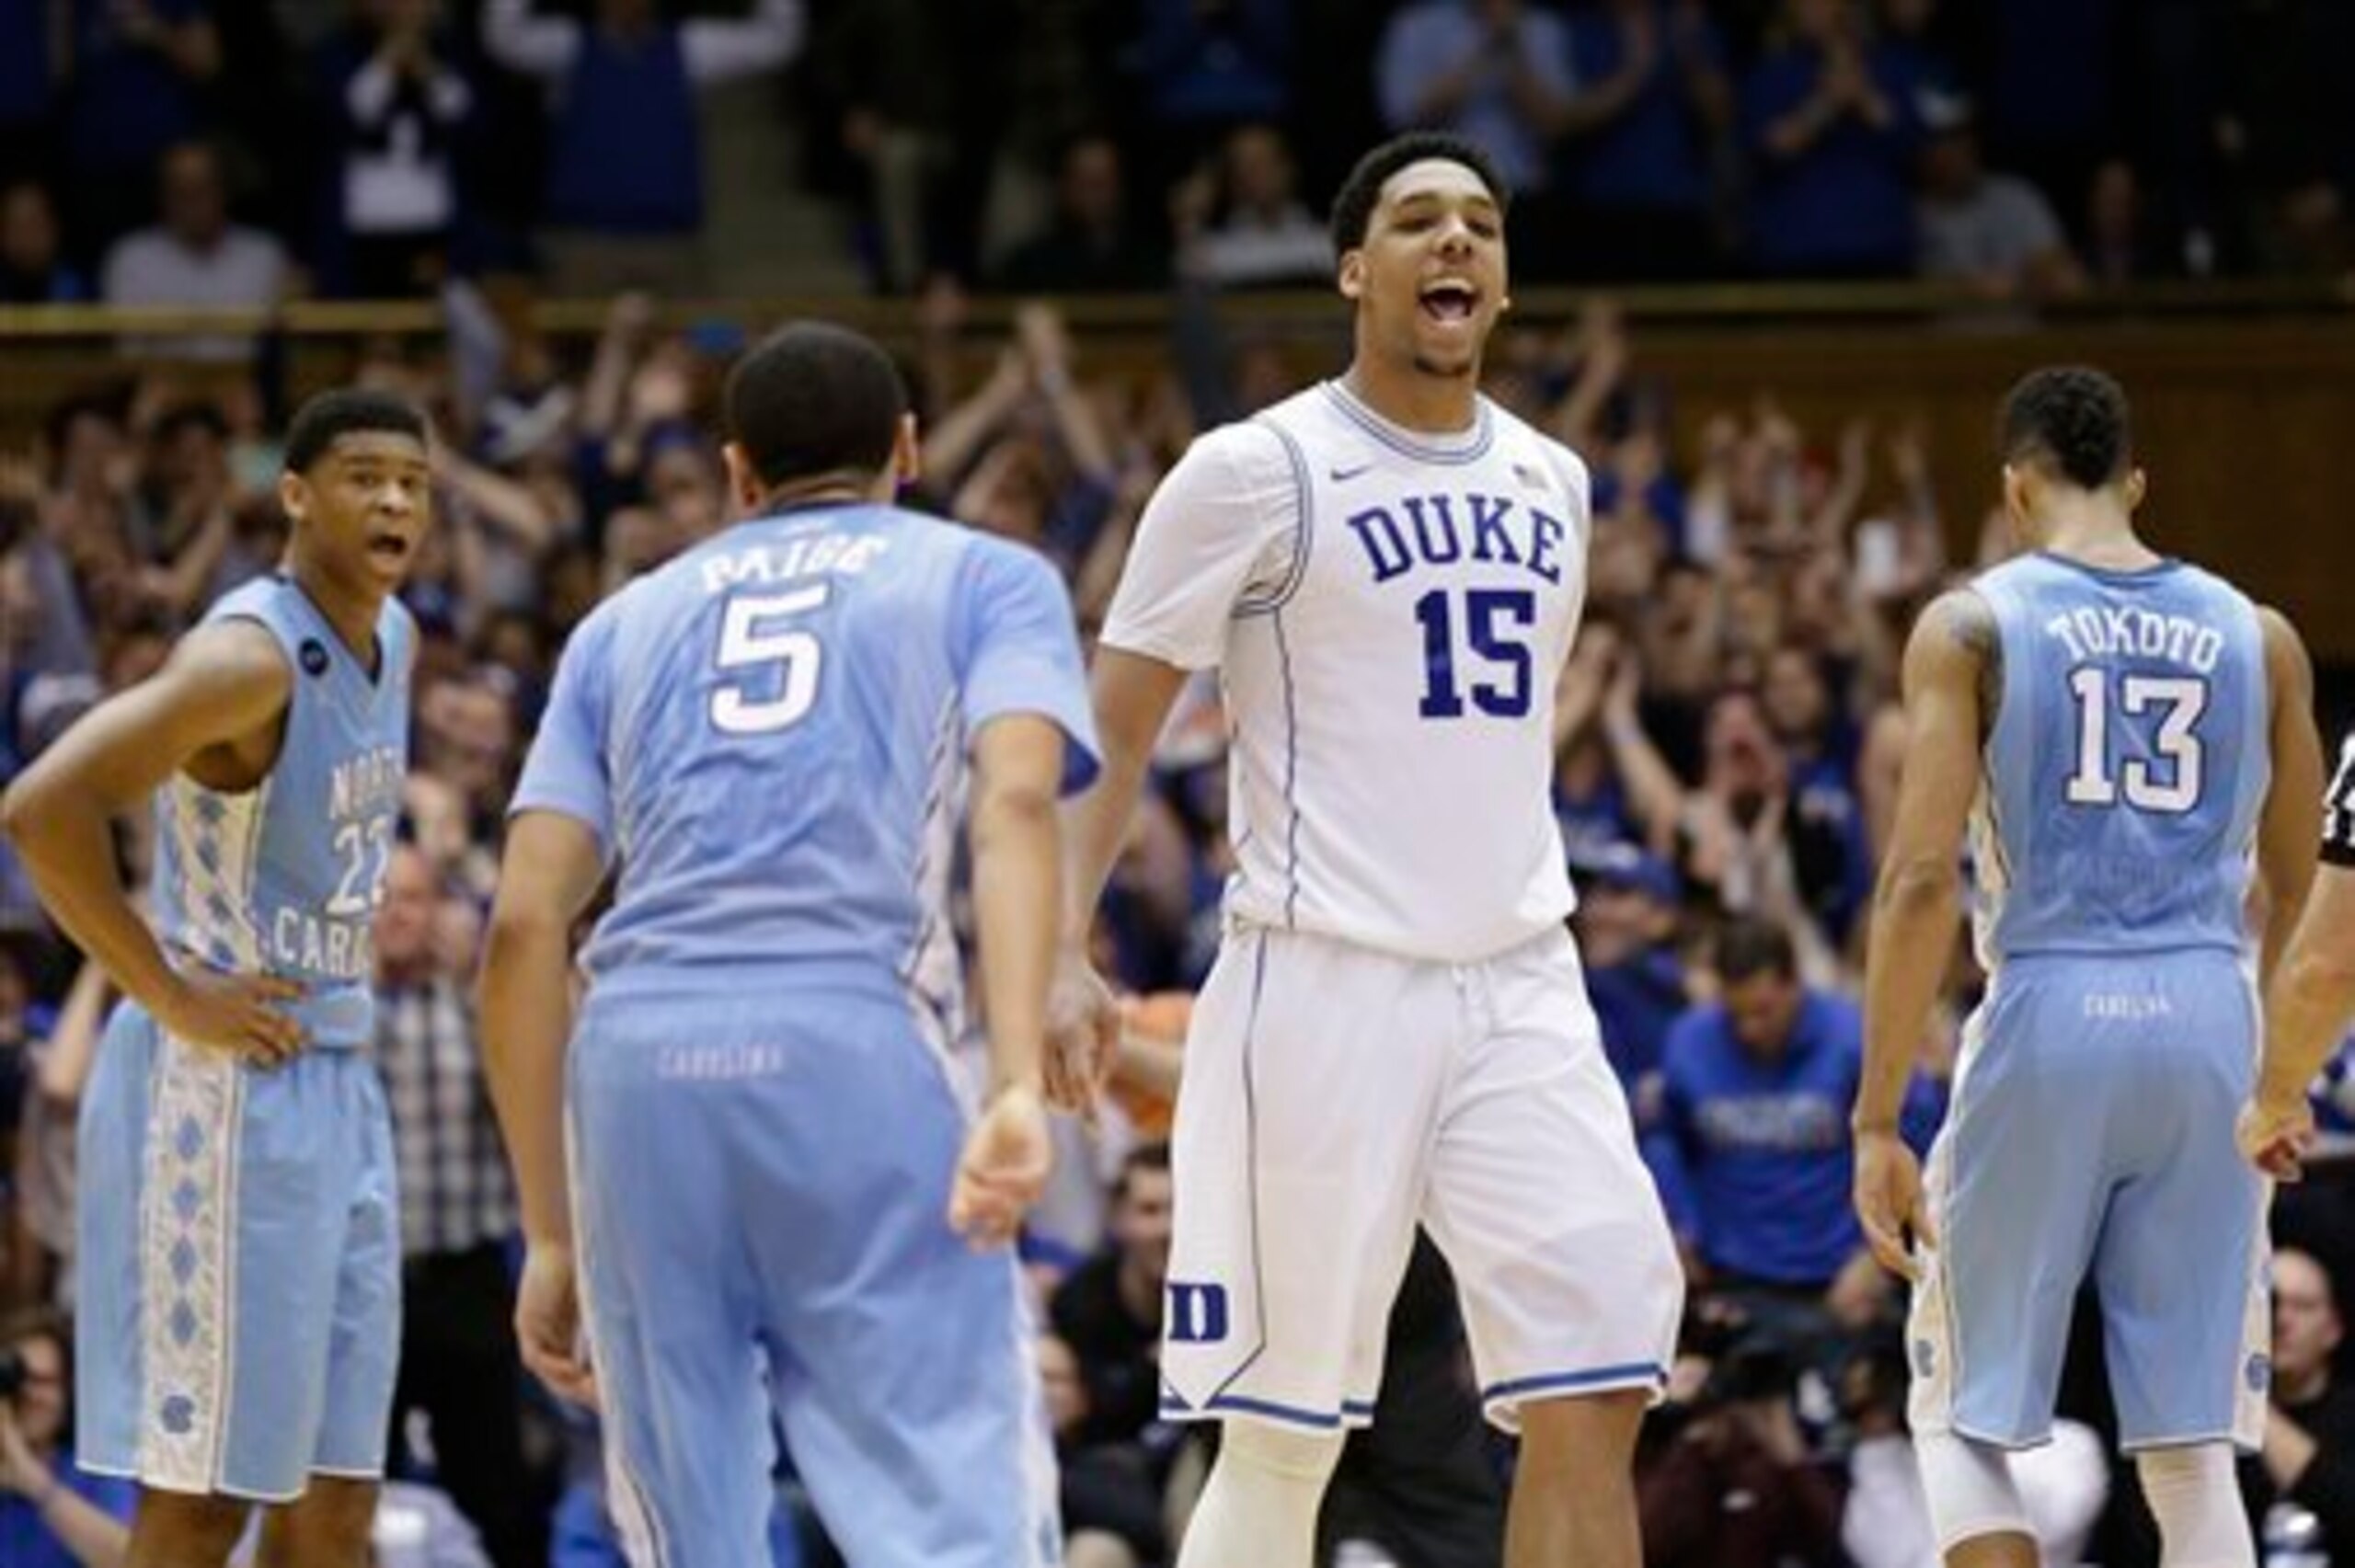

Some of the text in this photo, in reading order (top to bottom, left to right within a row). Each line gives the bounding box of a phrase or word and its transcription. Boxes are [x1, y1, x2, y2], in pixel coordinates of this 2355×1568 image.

[1346, 493, 1563, 584] DUKE
[709, 581, 829, 734] 5
[1414, 589, 1535, 718] 15
[2046, 604, 2222, 673] TOKOTO
[2067, 668, 2205, 813] 13
[1166, 1283, 1229, 1342] D
